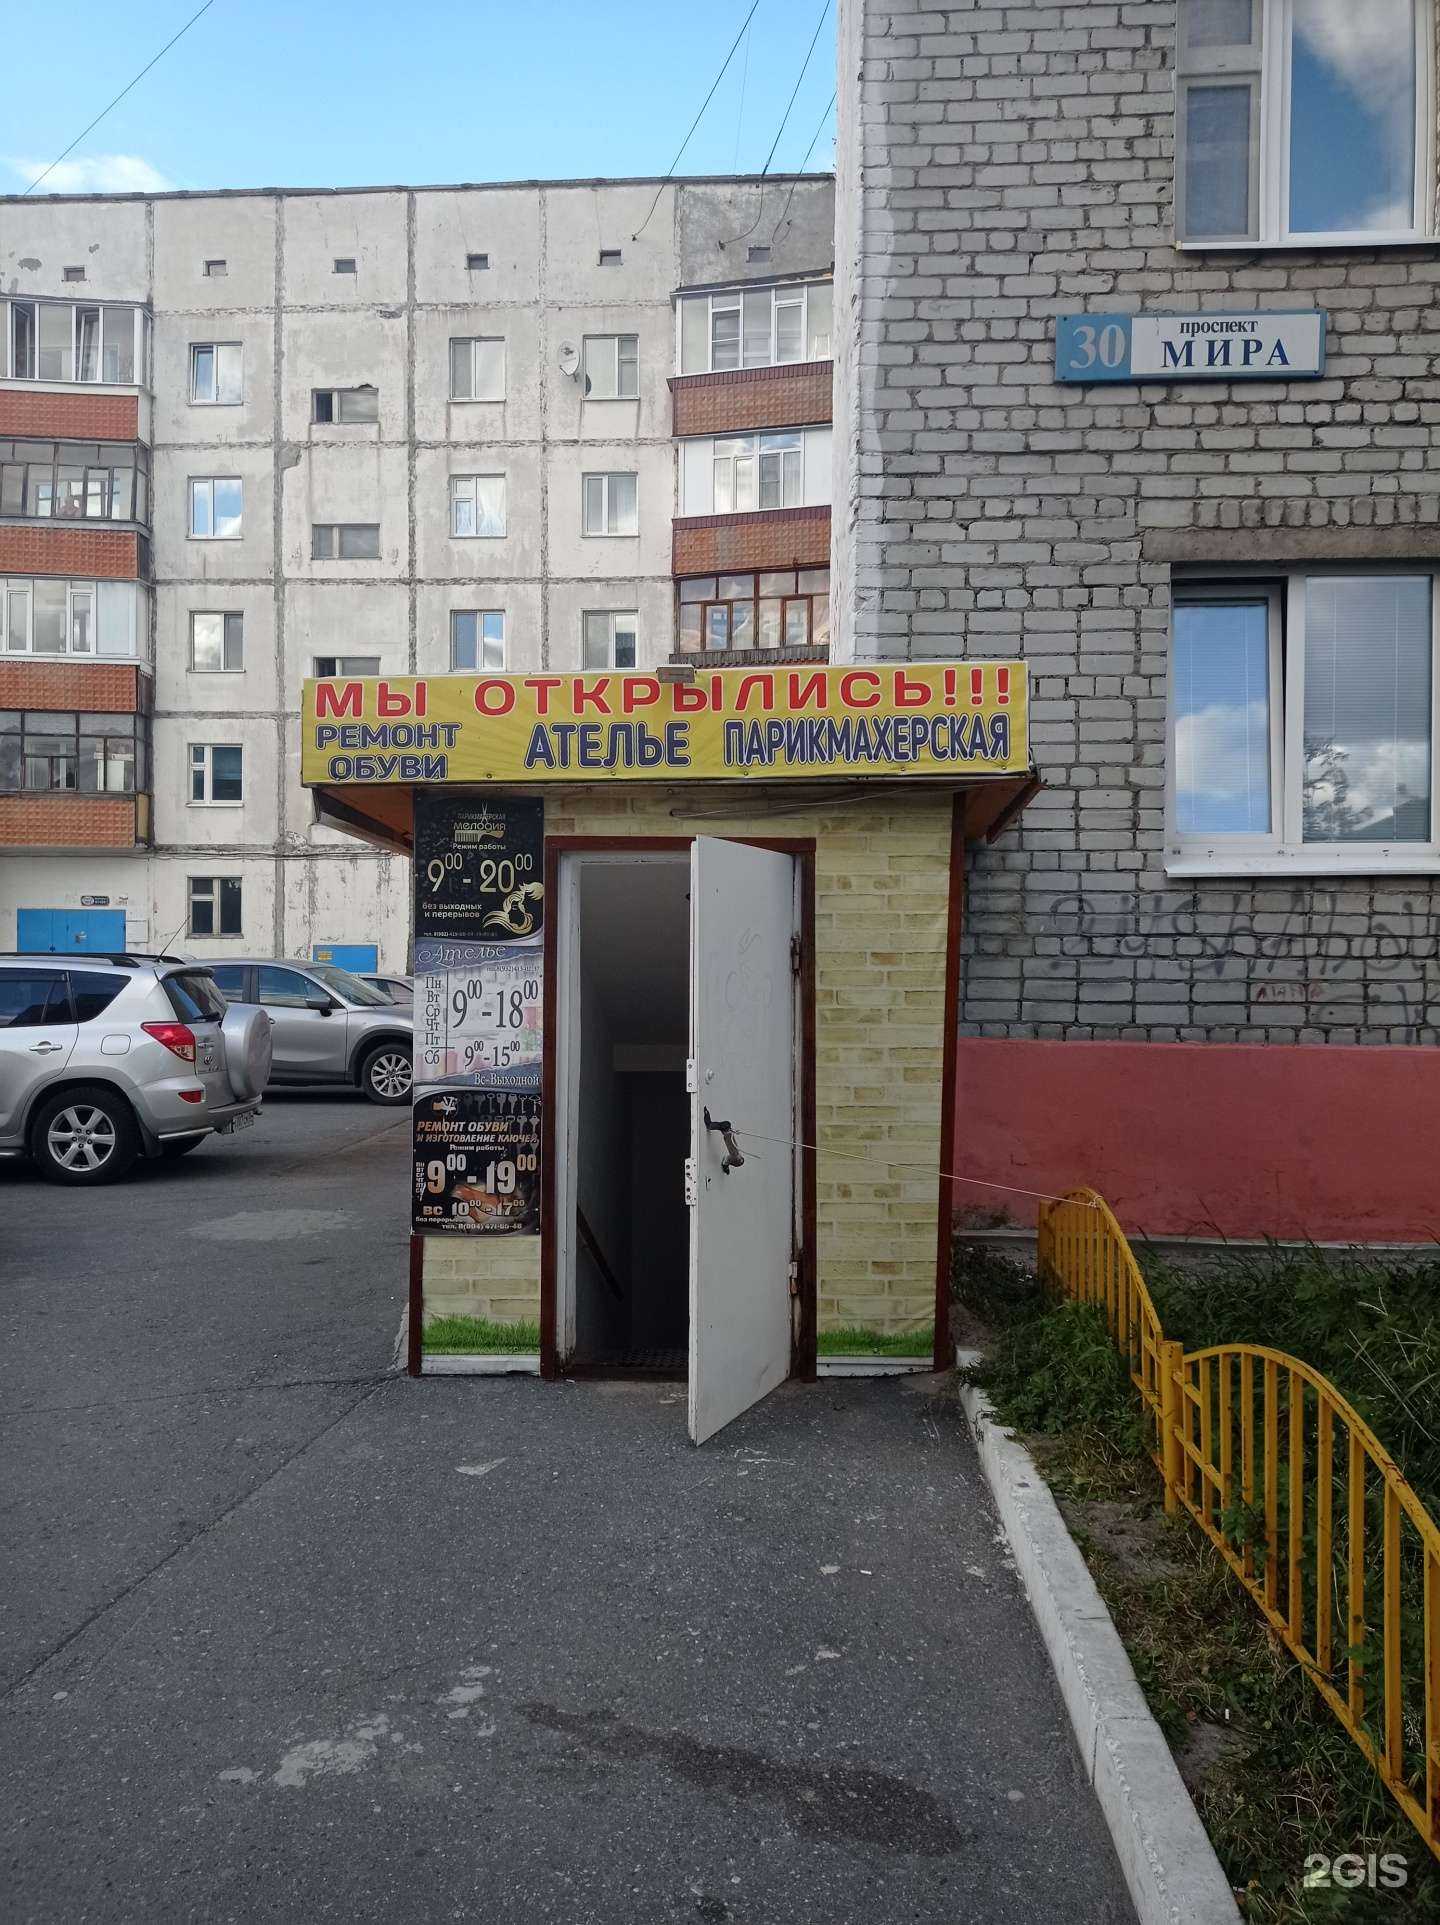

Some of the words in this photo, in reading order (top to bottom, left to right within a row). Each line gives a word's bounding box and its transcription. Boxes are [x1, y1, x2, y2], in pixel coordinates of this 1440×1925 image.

[1179, 320, 1259, 337] проспект
[1069, 324, 1126, 369] 30
[1160, 338, 1291, 368] МИРА
[315, 681, 427, 718] МЫ
[474, 667, 1010, 716] ОТКРЫЛИСЬ!!!
[315, 722, 463, 750] РЕМОНТ
[723, 712, 1010, 767] ПАРИКМАХЕРСКАЯ
[524, 719, 691, 769] АТЕЛЬЕ
[328, 753, 449, 780] ОБУВИ
[479, 843, 506, 851] работы
[422, 902, 437, 910] без
[439, 903, 482, 911] выходных
[432, 911, 480, 919] перерывов
[425, 976, 441, 989] Пн
[427, 990, 440, 1003] Вт
[425, 1004, 440, 1020] Ср
[426, 1018, 440, 1031] Чт
[425, 1033, 440, 1045] Пт
[424, 1050, 440, 1064] Сб
[416, 1121, 466, 1132] РЕМОНТ
[468, 1121, 510, 1132] ОБУВИ
[427, 1134, 495, 1143] ИЗГОТОВЛЕНИЕ
[423, 1206, 443, 1215] ВС
